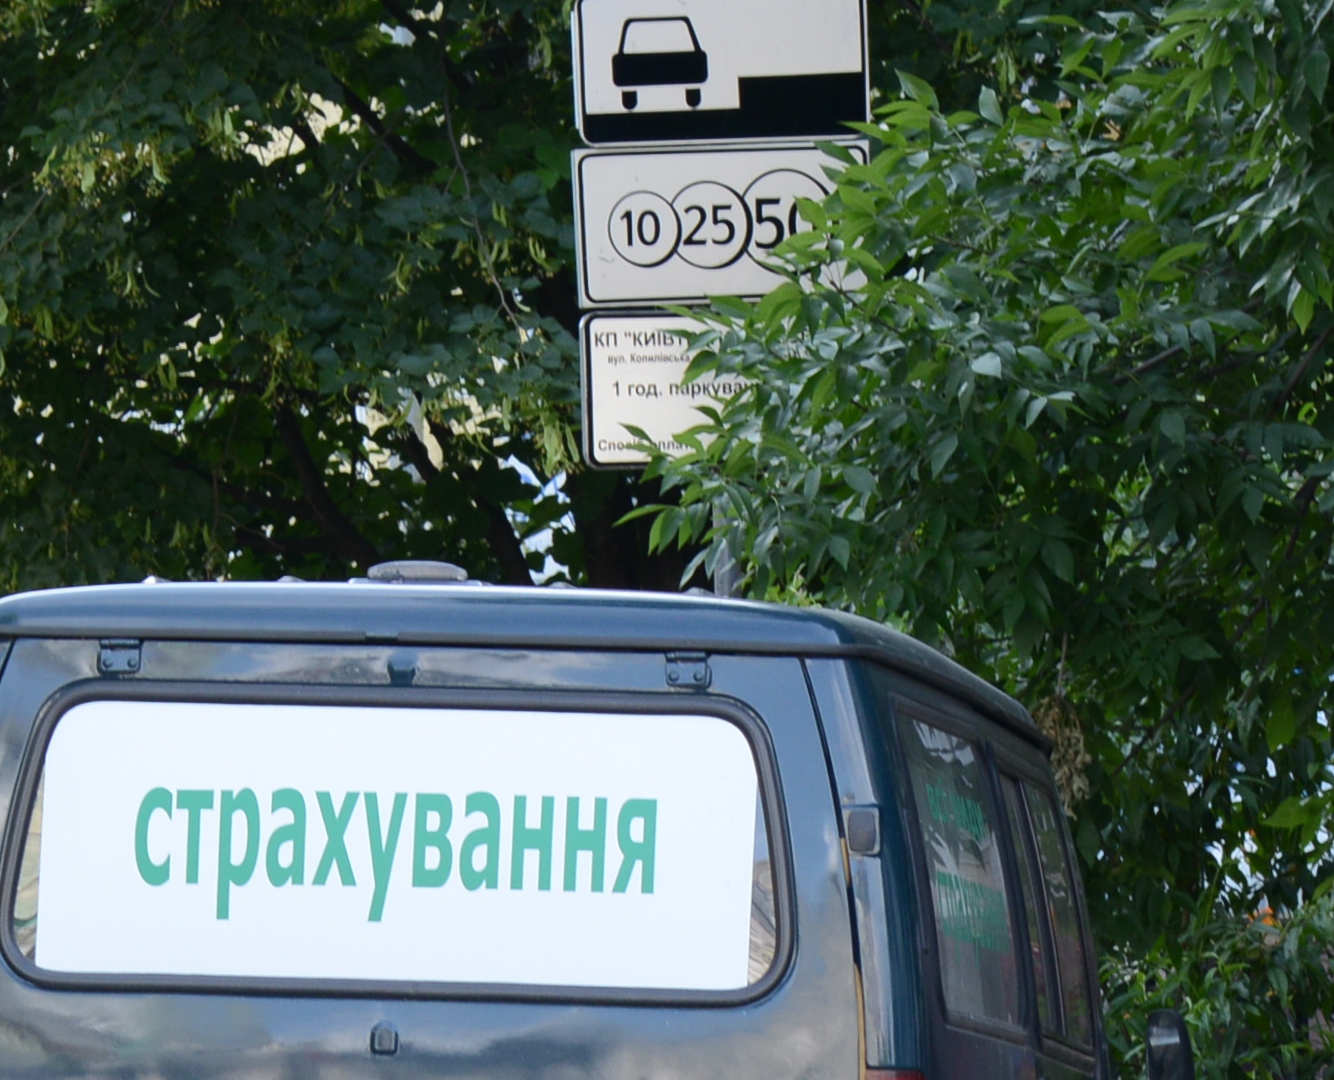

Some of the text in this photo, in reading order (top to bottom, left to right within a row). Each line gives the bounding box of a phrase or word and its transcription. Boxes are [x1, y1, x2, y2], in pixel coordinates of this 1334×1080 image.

[620, 209, 661, 247] 10
[683, 204, 736, 245] 25
[594, 331, 618, 347] КП
[607, 354, 627, 366] вул.
[612, 380, 620, 396] 1
[627, 383, 663, 400] год.
[133, 785, 659, 923] страхування
